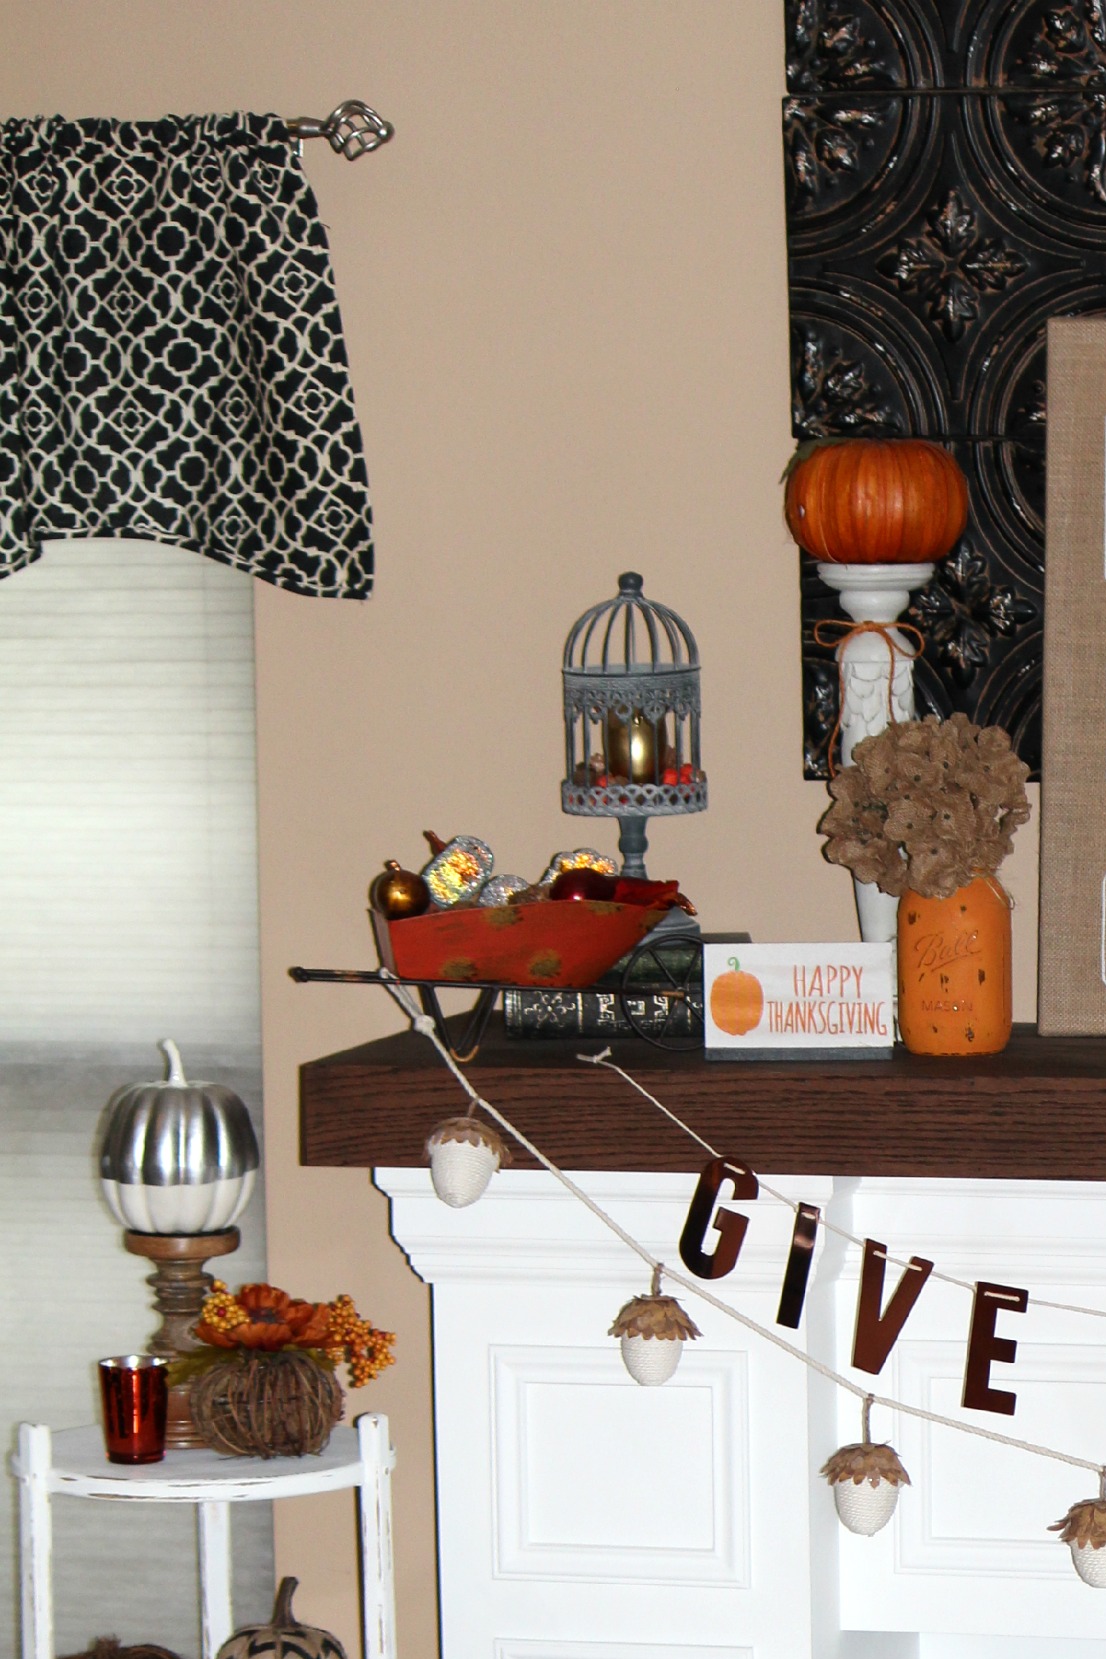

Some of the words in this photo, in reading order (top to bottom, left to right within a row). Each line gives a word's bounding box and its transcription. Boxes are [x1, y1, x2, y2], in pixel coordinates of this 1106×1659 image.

[914, 930, 982, 970] Ball
[793, 964, 863, 999] HAPPY
[767, 1001, 888, 1036] THANKSGIVING
[679, 1155, 1029, 1416] GIVE
